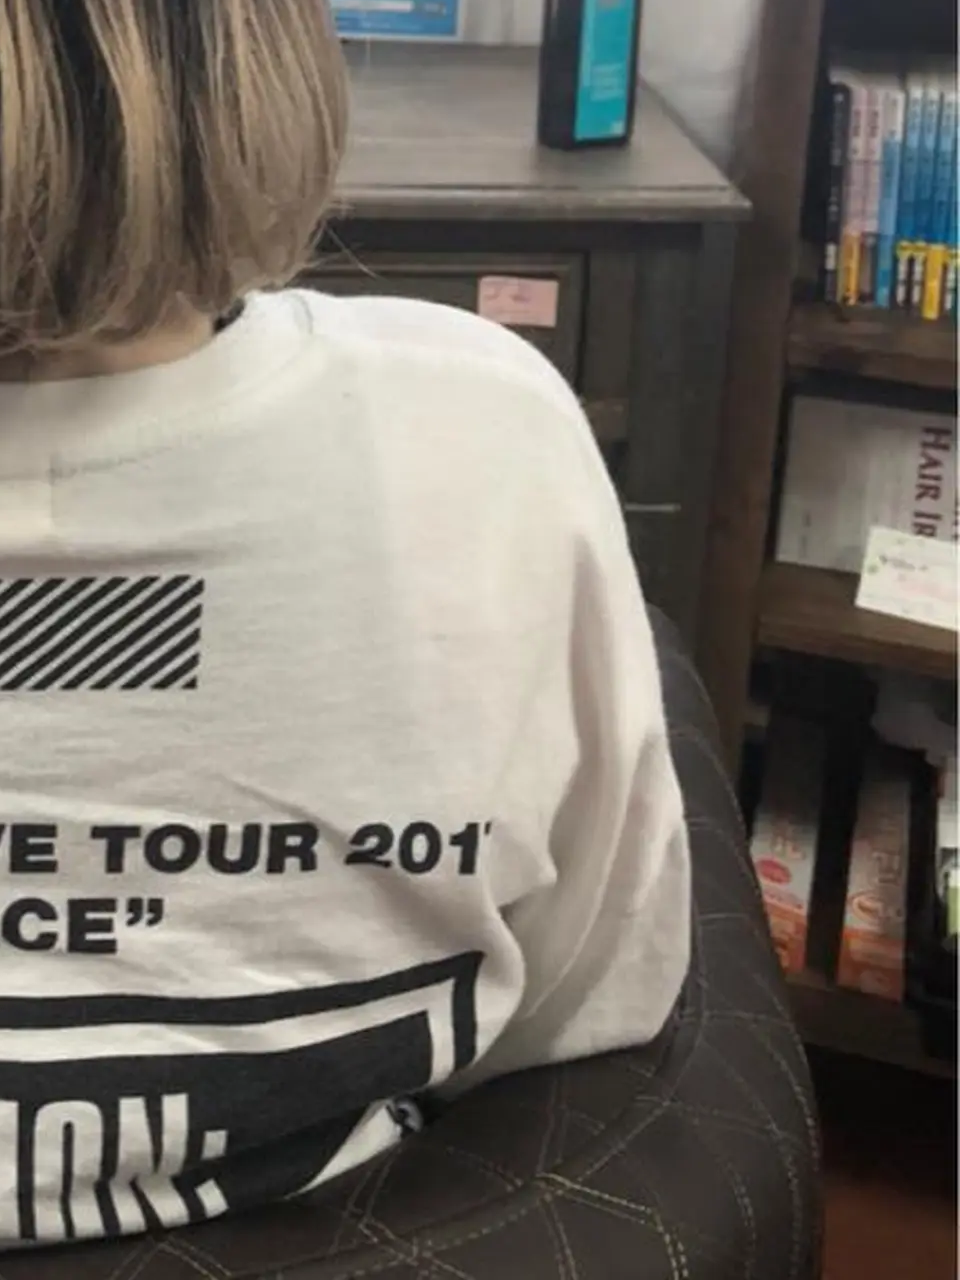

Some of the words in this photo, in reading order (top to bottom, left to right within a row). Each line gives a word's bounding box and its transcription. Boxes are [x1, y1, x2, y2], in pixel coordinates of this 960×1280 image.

[915, 426, 952, 502] HAIR
[91, 820, 319, 875] TOUR
[344, 820, 493, 875] 201
